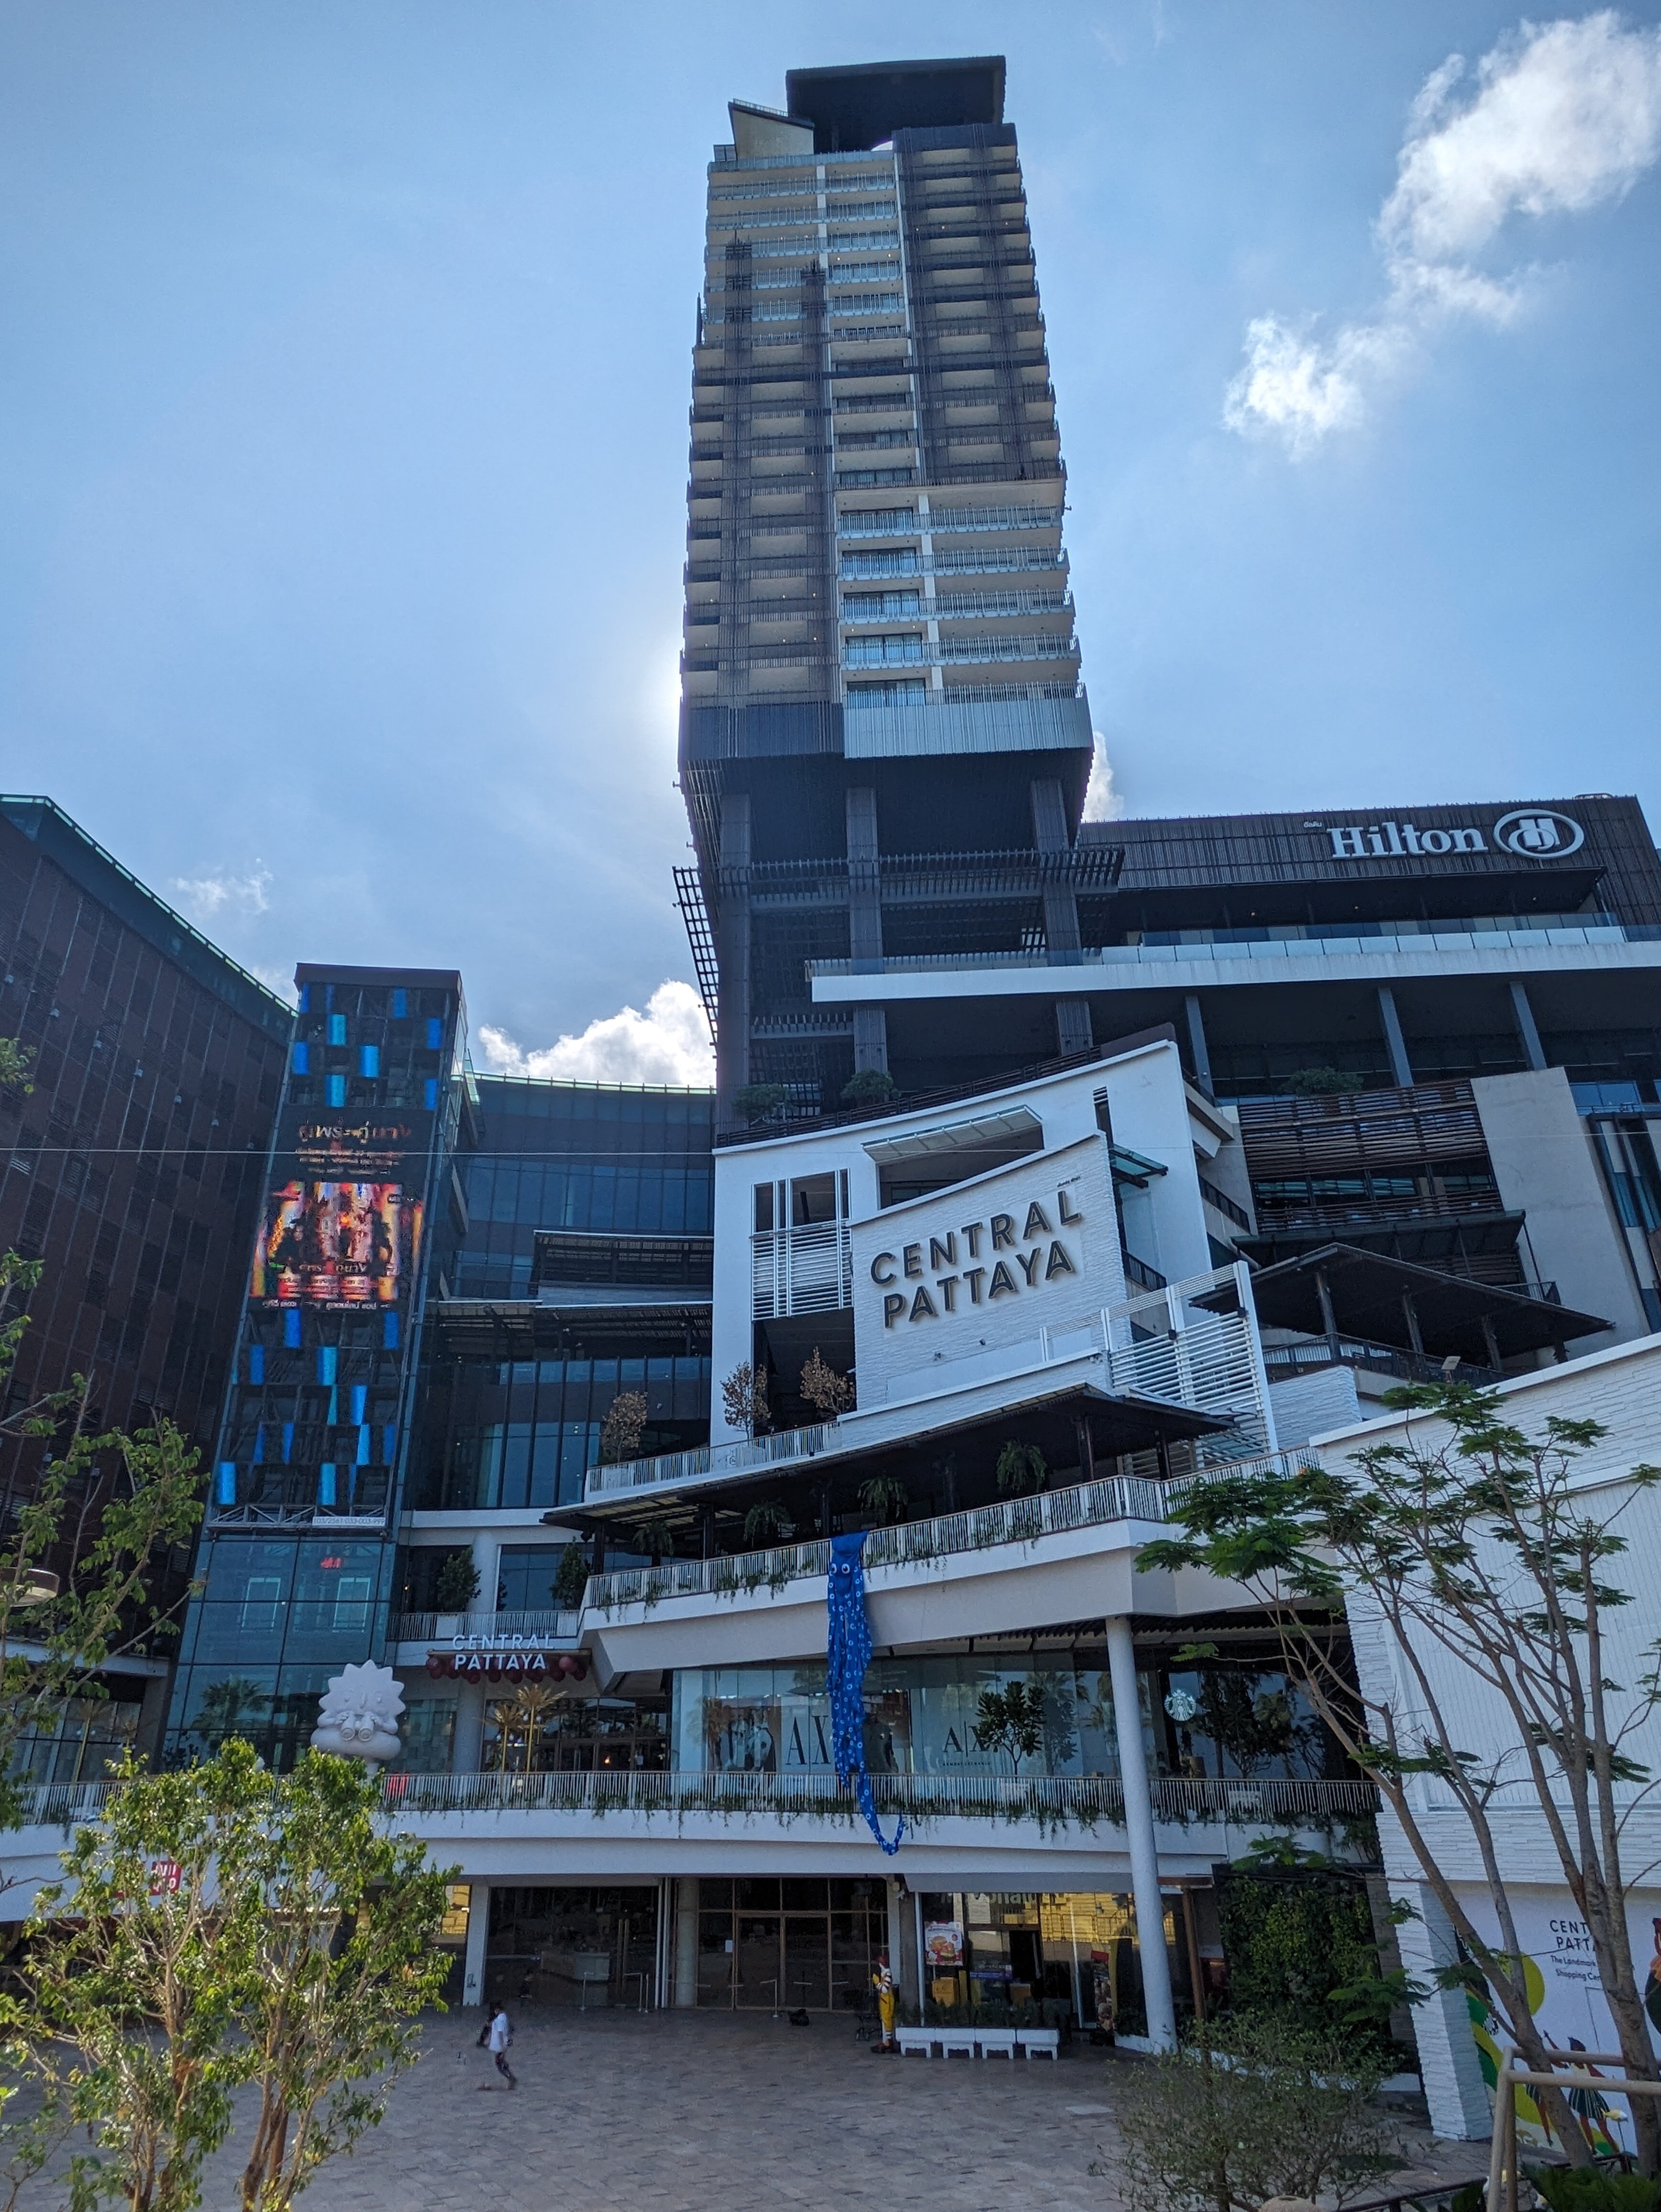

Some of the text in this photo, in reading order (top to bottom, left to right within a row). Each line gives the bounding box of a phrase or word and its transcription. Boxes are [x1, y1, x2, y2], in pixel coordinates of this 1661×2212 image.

[1327, 822, 1488, 859] Hilton
[871, 1190, 1081, 1284] CENTRAL
[884, 1240, 1074, 1328] PATTAYA
[452, 1634, 554, 1650] CENTRAL
[455, 1654, 546, 1670] PATTAYA
[1550, 1920, 1587, 1934] CENT
[1556, 1936, 1596, 1951] PATT
